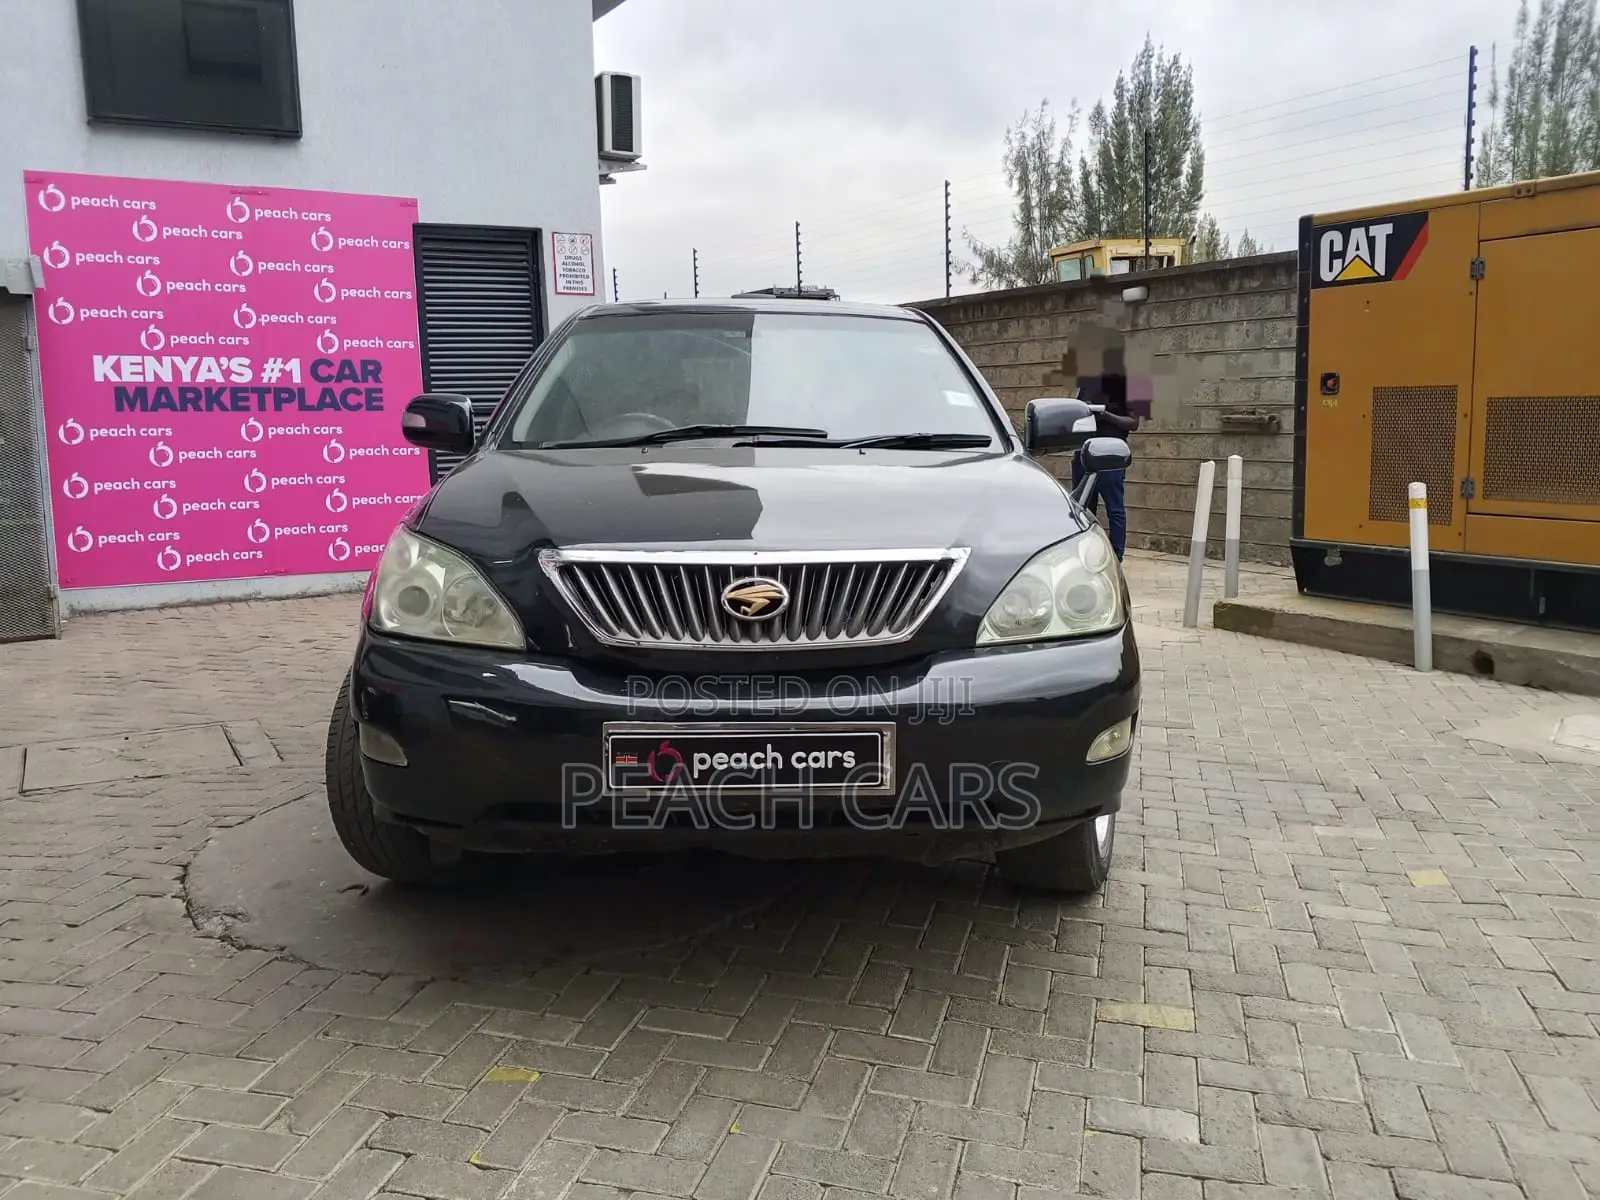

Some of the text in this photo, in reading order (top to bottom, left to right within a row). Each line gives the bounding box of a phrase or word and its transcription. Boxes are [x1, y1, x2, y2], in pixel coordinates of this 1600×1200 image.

[71, 195, 156, 210] peach cars
[255, 208, 331, 222] peach cars
[163, 225, 243, 239] peach cars
[338, 236, 410, 249] peach cars
[76, 251, 160, 266] peach cars
[1320, 223, 1393, 281] CAT
[258, 260, 334, 273] peach cars
[167, 279, 246, 294] peach cars
[341, 287, 412, 300] peach cars
[80, 306, 164, 321] peach cars
[262, 312, 336, 326] peach cars
[171, 332, 249, 347] peach cars
[344, 337, 415, 350] peach cars
[93, 355, 383, 383] KENYA'S #1 CAR
[114, 386, 384, 412] MARKETPLACE
[90, 424, 172, 440] peach cars
[269, 423, 343, 438] peach cars
[179, 447, 257, 463] peach cars
[350, 445, 420, 459] peach cars
[95, 478, 176, 494] peach cars
[272, 473, 345, 488] peach cars
[183, 498, 259, 515] peach cars
[353, 493, 391, 508] peach
[275, 523, 348, 539] peach cars
[99, 531, 180, 547] peach cars
[187, 550, 263, 566] peach cars
[693, 743, 856, 779] peach cars
